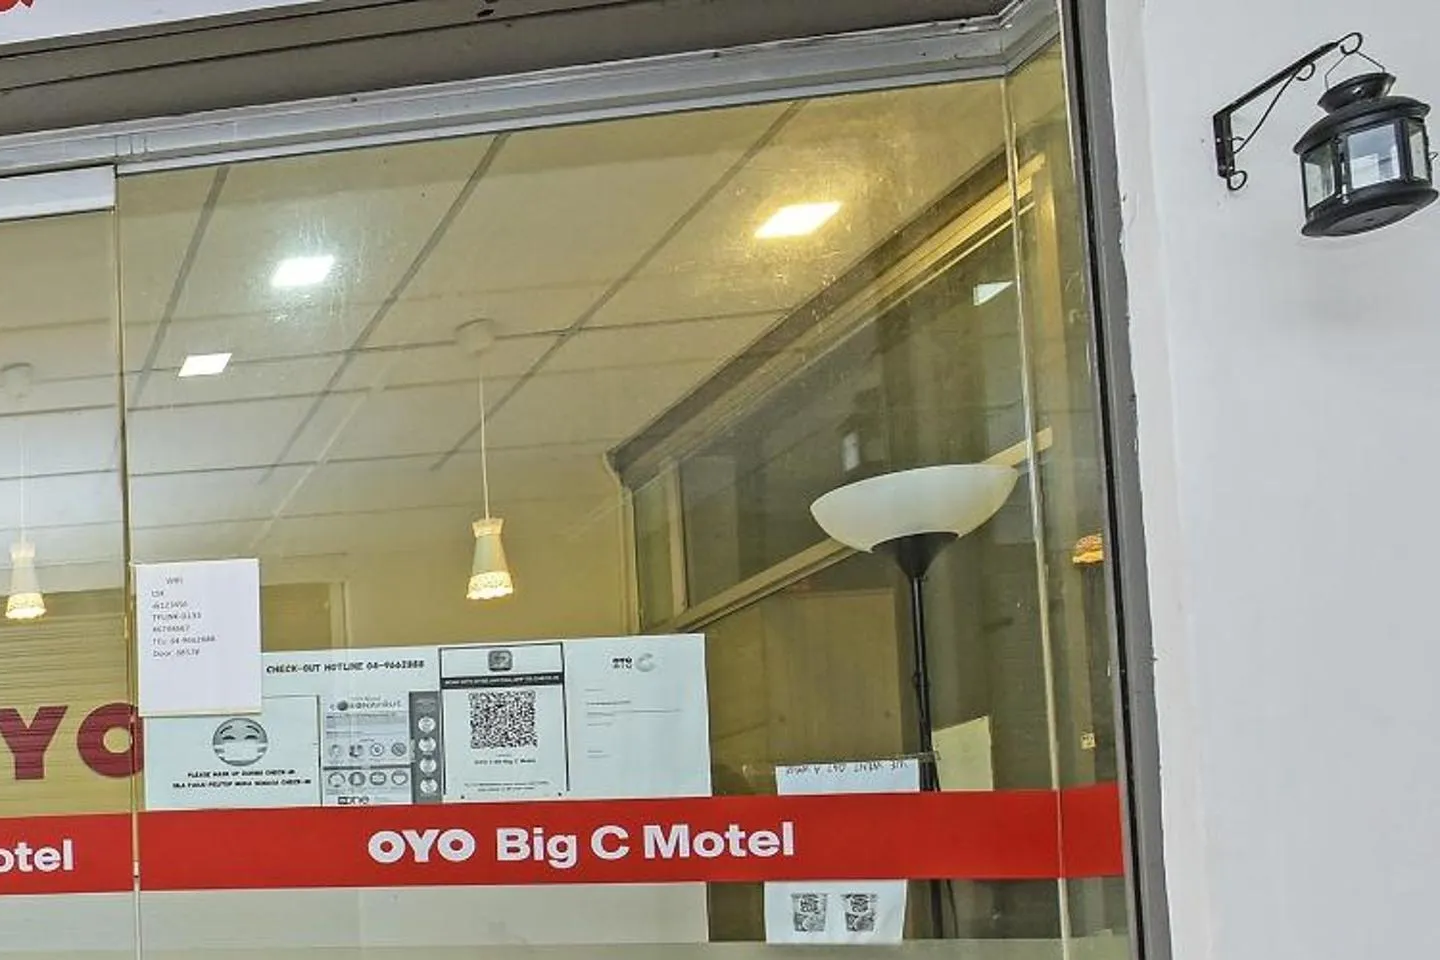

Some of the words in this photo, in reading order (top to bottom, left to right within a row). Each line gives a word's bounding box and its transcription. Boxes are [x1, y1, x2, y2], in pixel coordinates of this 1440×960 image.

[368, 828, 476, 863] OYO
[496, 826, 577, 869] Big
[591, 825, 629, 860] C
[643, 821, 795, 859] Motel
